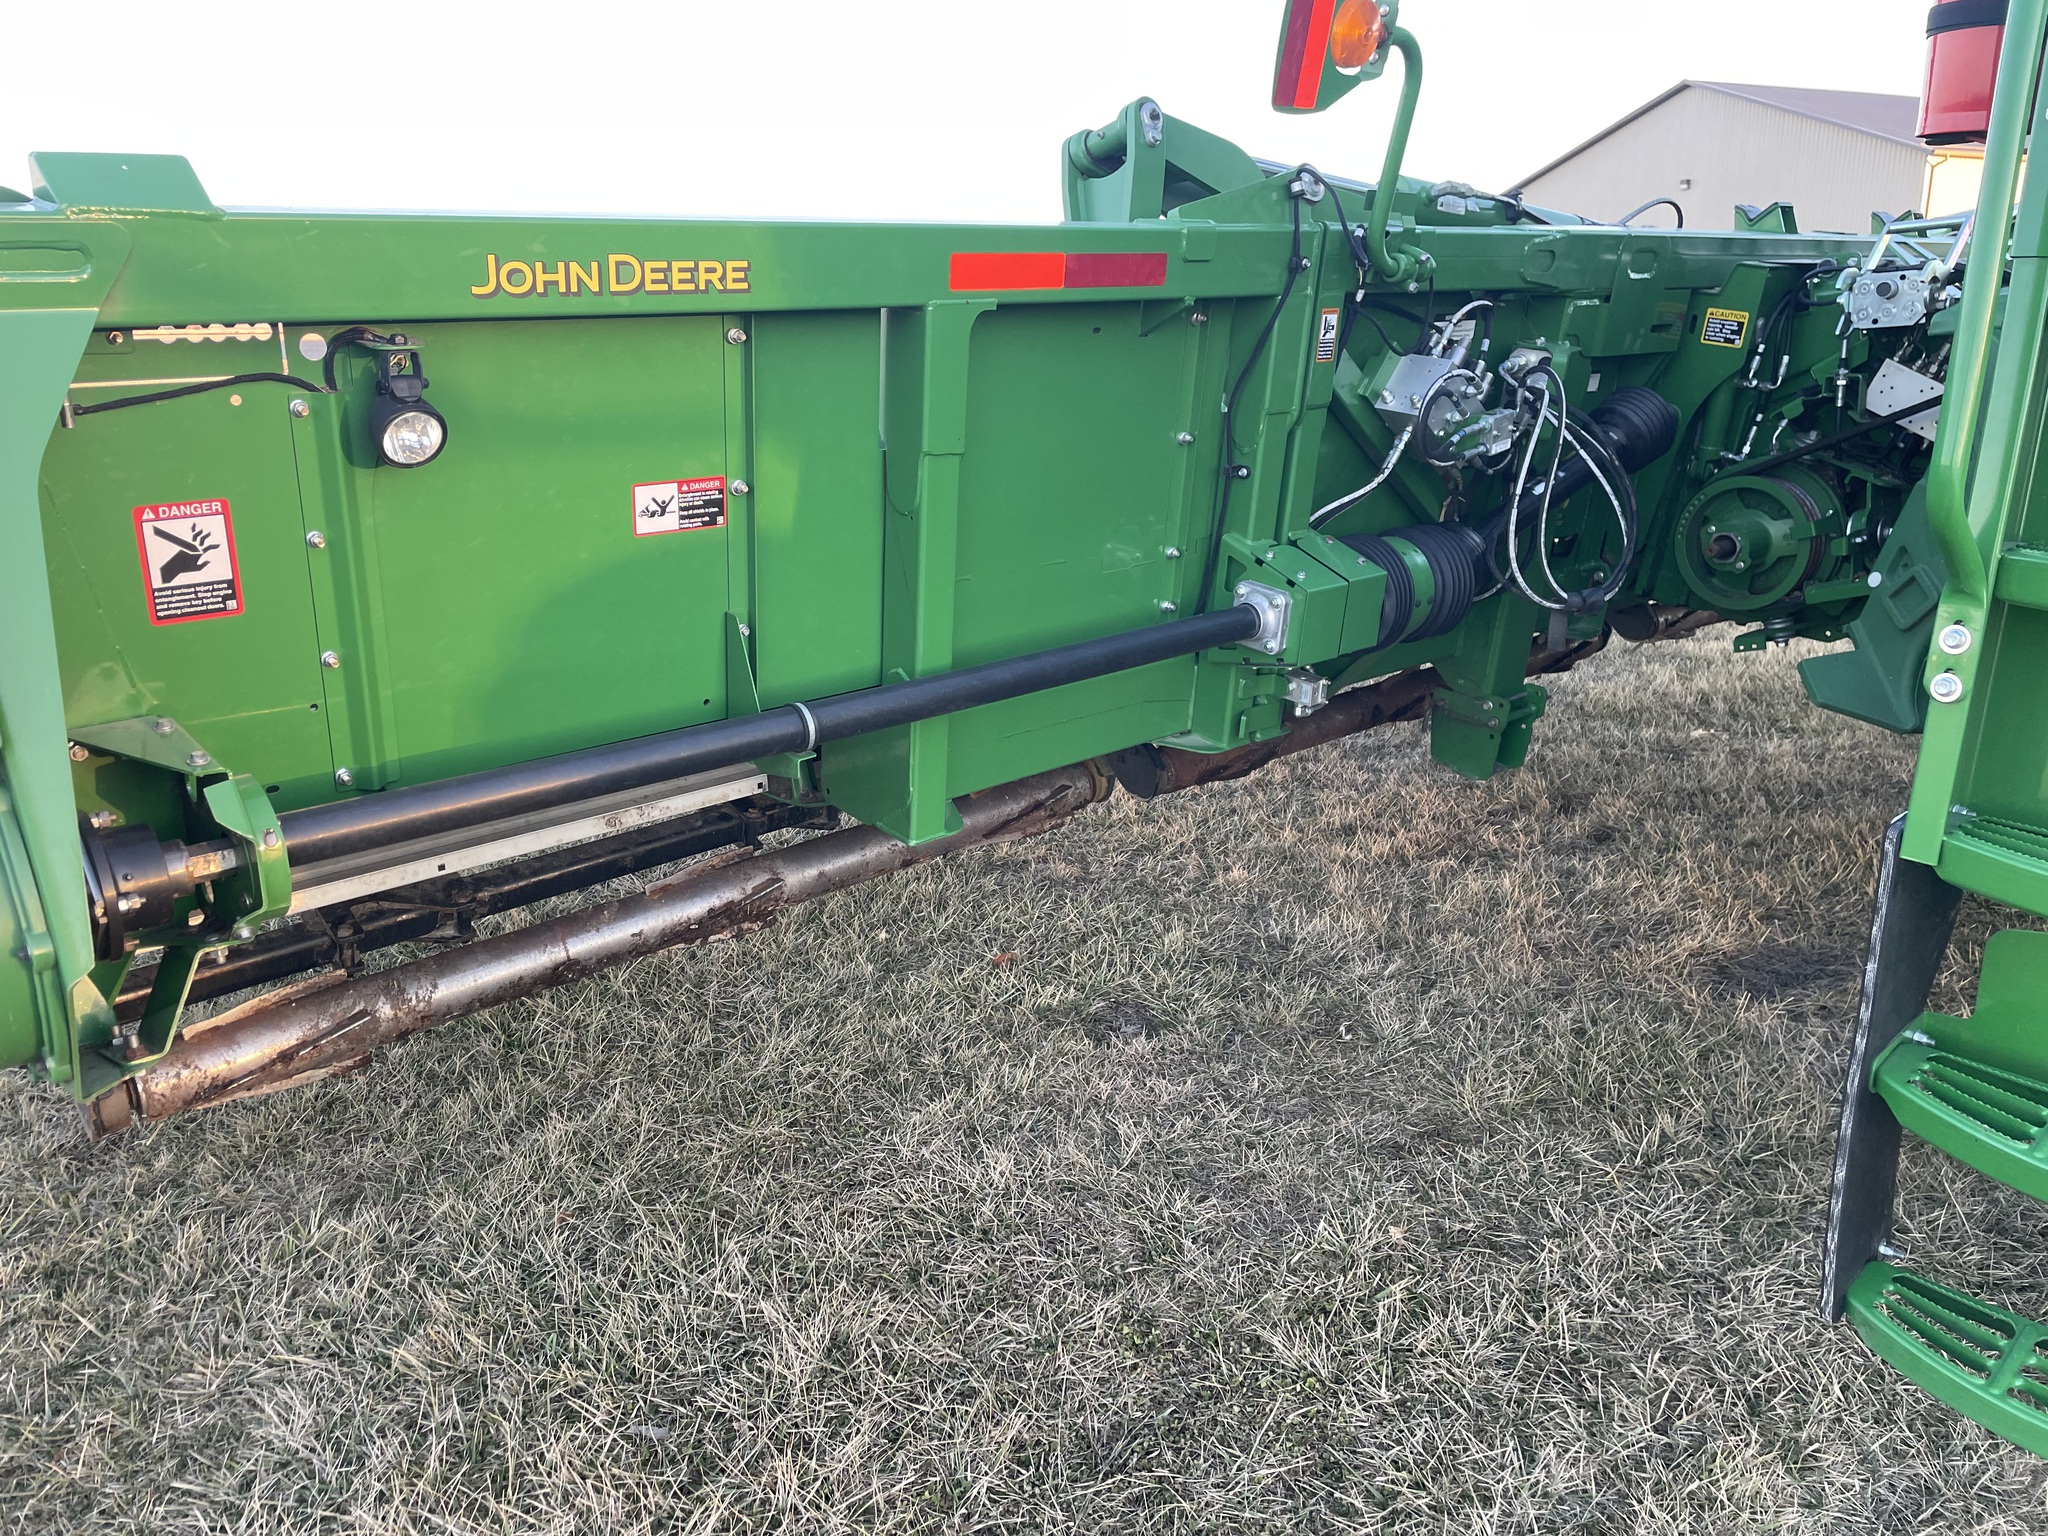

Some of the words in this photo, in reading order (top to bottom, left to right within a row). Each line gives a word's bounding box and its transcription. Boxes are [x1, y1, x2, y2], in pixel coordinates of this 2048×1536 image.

[470, 253, 602, 297] JOHN
[607, 252, 751, 295] DEERE
[1715, 310, 1747, 320] CAUTION
[690, 481, 720, 490] DANGER
[158, 502, 222, 518] DANGER
